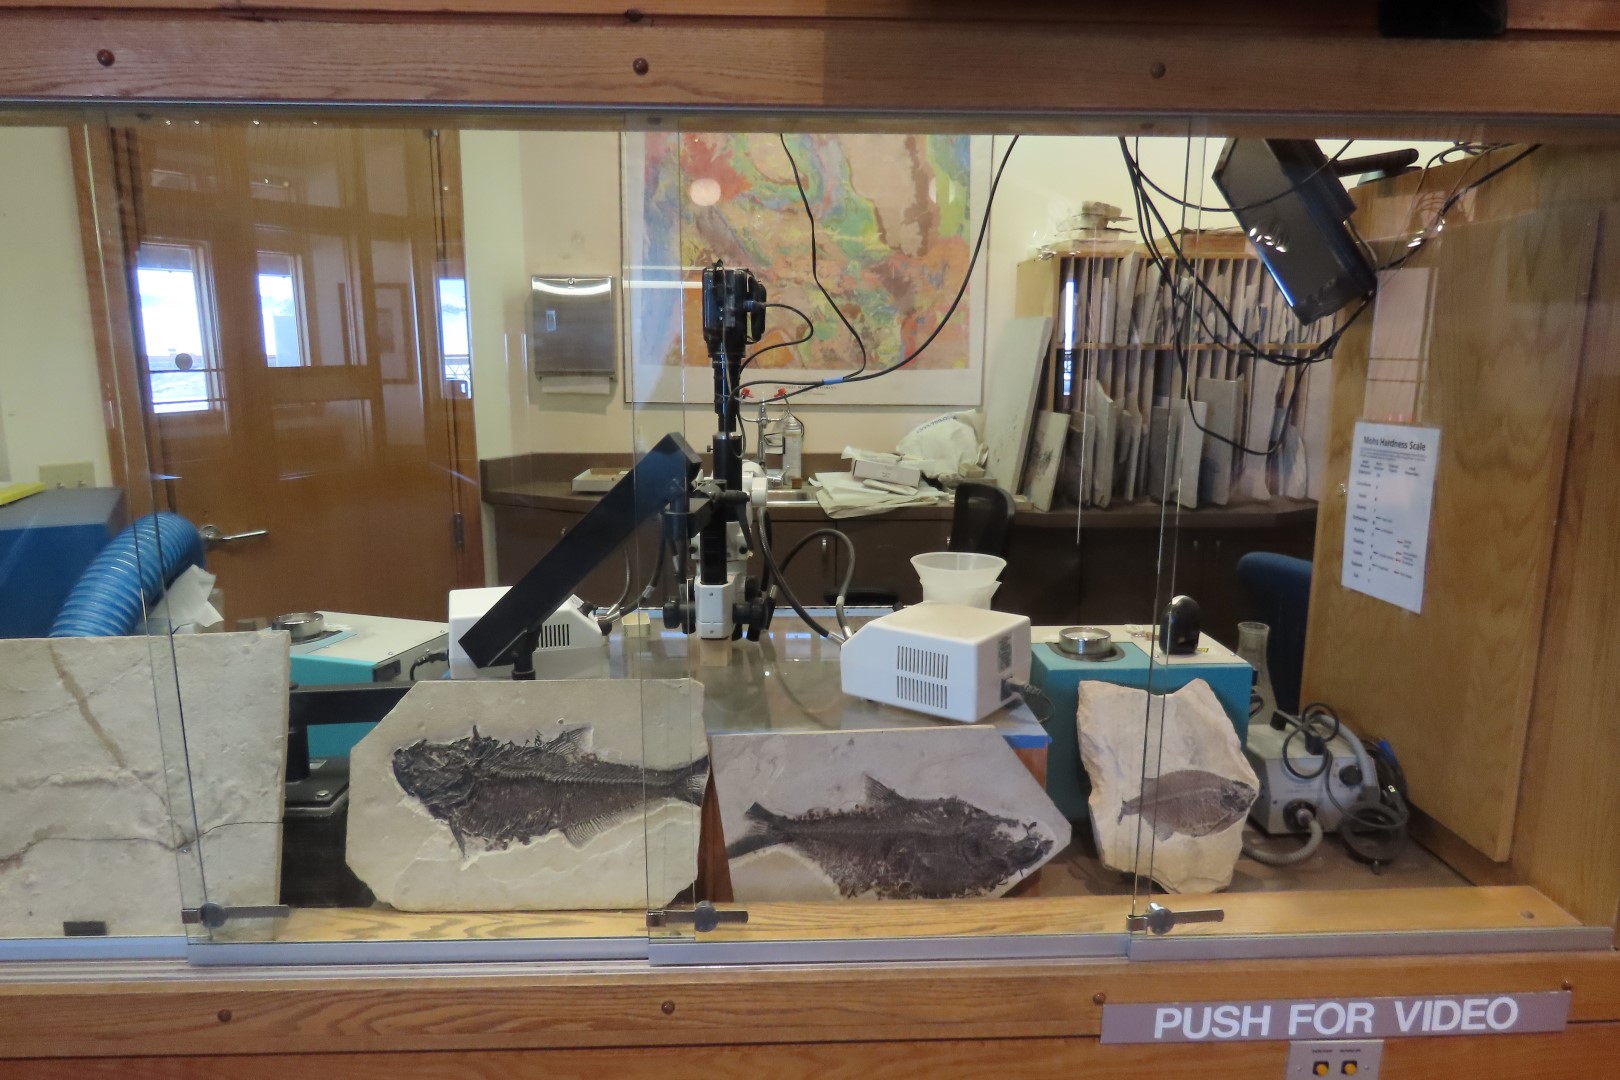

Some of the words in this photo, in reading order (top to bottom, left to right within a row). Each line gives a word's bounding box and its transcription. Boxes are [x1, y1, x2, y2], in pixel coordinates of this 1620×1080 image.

[1363, 436, 1379, 446] Mohs
[1380, 438, 1408, 449] Hardness
[1409, 440, 1426, 451] Scale
[1155, 1006, 1271, 1039] PUSH
[1289, 1002, 1374, 1035] FOR
[1395, 997, 1518, 1031] VIDEO
